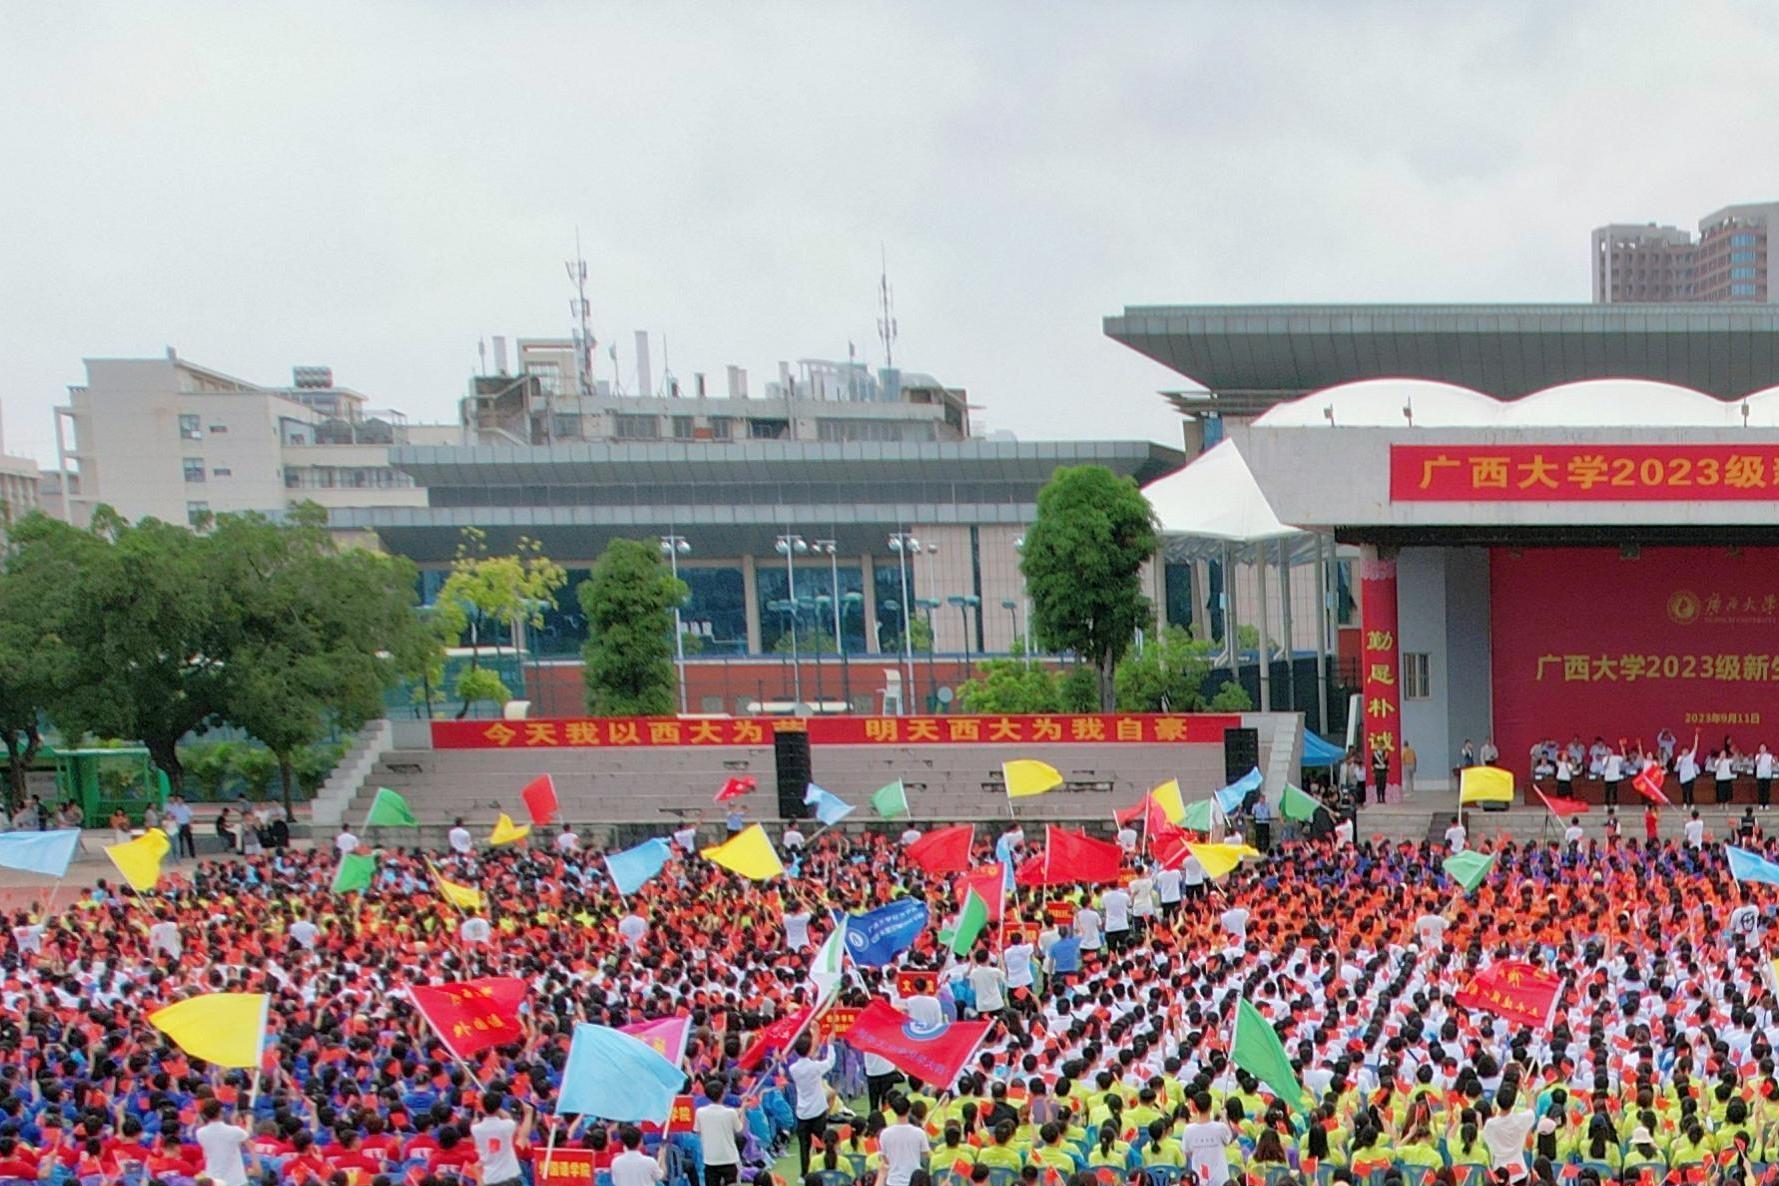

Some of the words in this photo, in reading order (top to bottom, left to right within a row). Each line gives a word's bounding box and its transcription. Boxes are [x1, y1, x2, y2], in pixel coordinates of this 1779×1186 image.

[866, 714, 1189, 743] 明天西大为我自豪
[1685, 712, 1760, 725] 2023年9月11日
